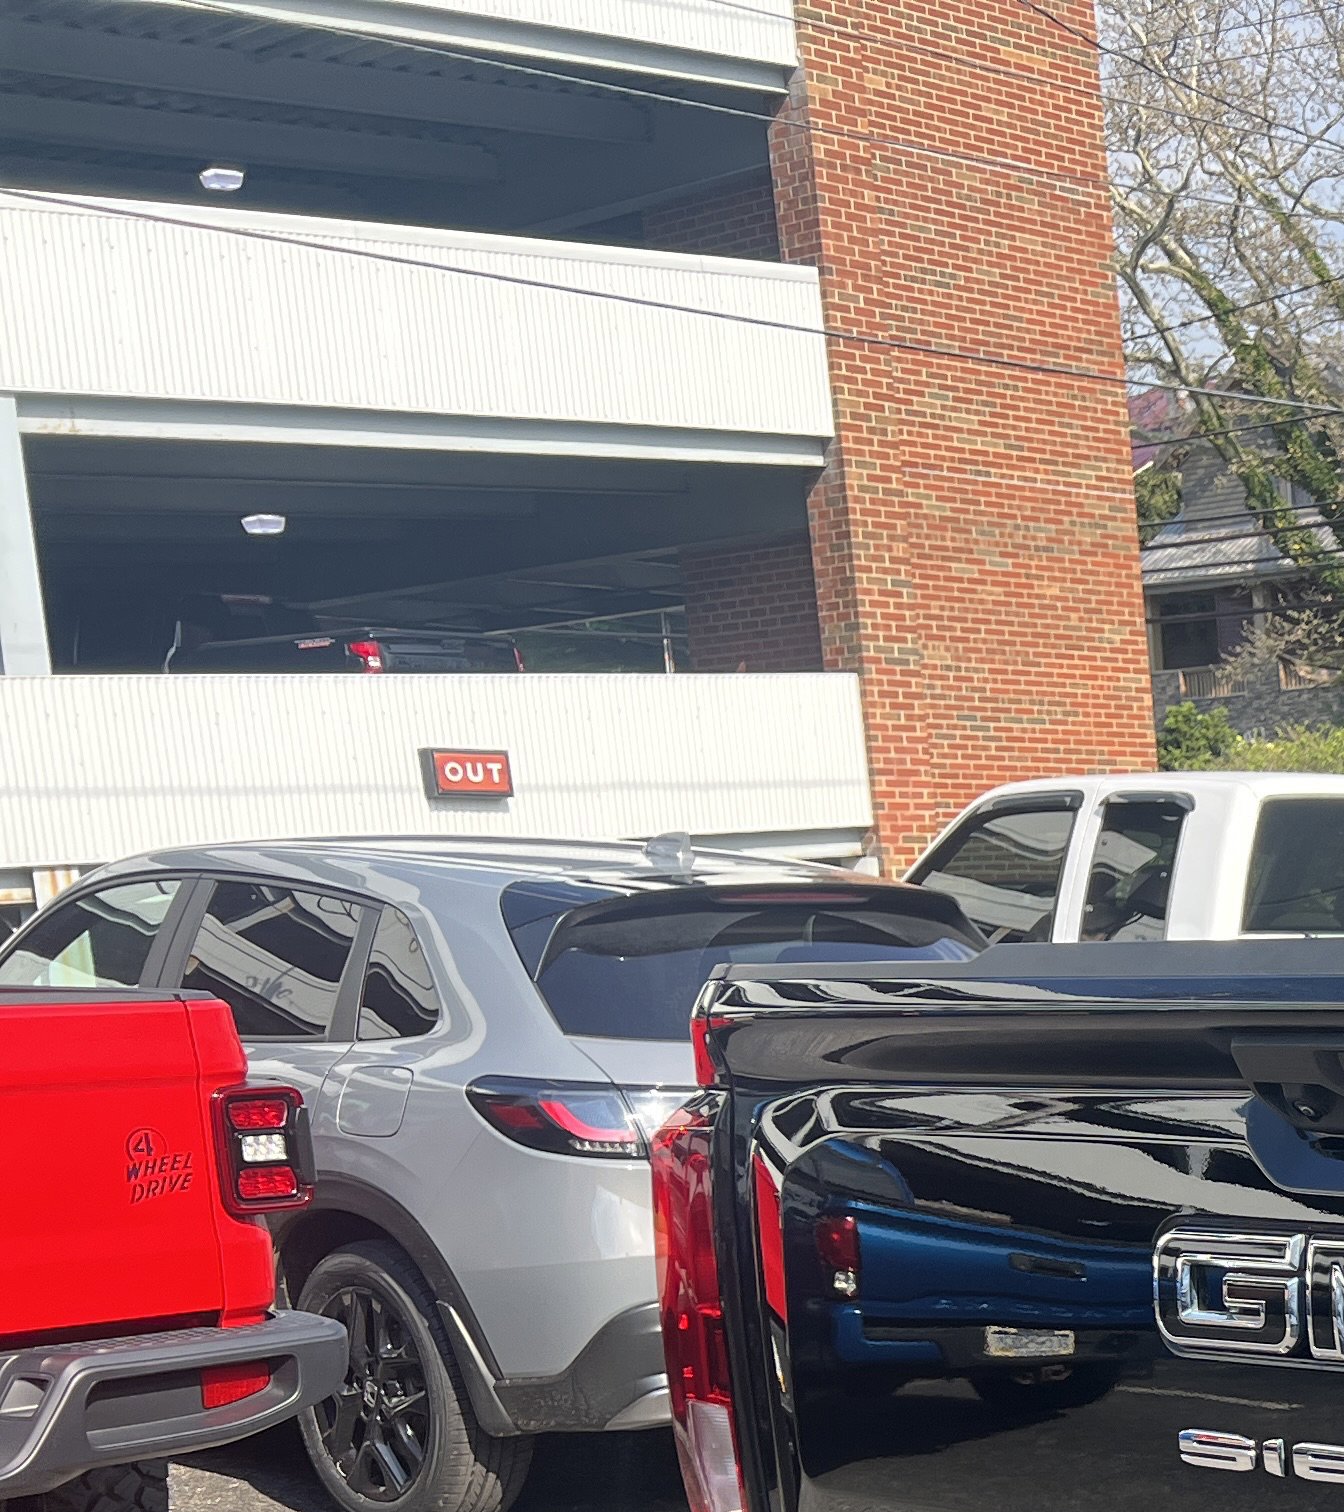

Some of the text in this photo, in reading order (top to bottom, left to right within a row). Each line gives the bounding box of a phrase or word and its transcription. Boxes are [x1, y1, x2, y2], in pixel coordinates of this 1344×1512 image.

[444, 761, 503, 784] OUT
[133, 1132, 153, 1156] 4
[126, 1151, 192, 1182] WHEEL
[131, 1173, 193, 1204] DRIVE
